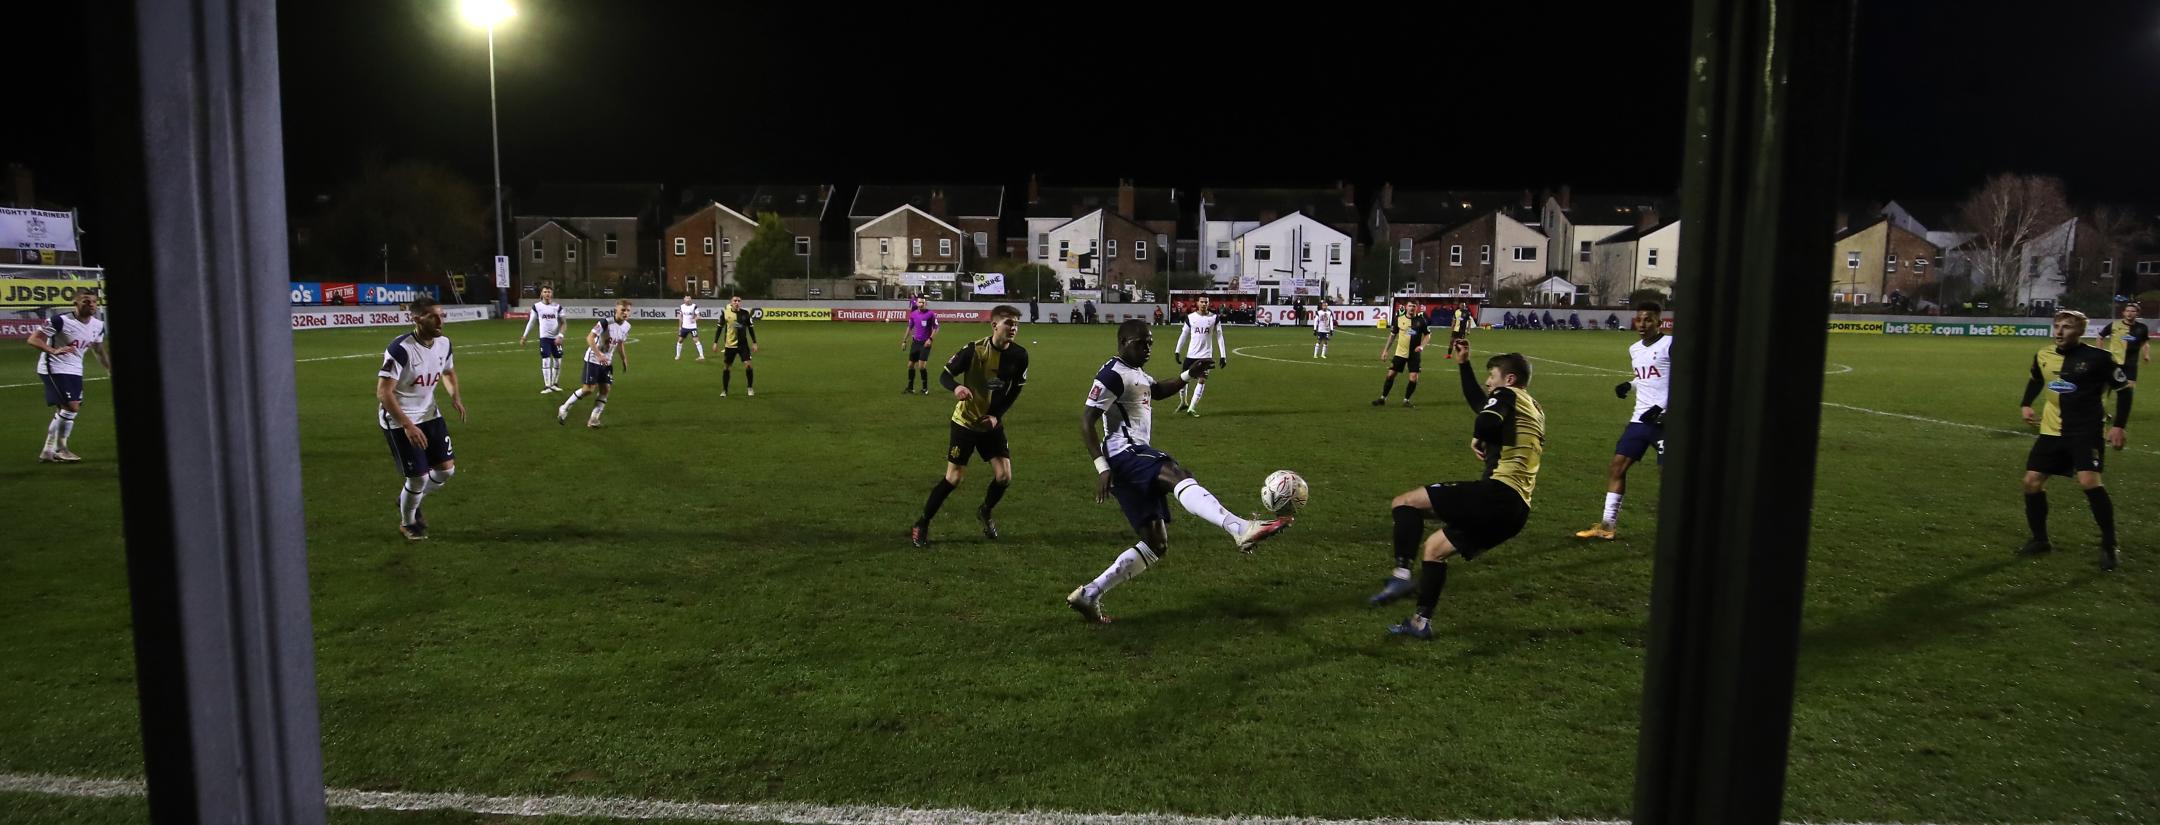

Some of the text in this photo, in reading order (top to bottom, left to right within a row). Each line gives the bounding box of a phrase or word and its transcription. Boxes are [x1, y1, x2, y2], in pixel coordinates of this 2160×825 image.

[31, 210, 70, 219] MARINERS
[977, 275, 1002, 291] MARINE
[344, 287, 355, 296] THIS
[376, 286, 433, 303] Domino's
[332, 313, 364, 325] 32Red
[369, 312, 400, 324] 32Red
[640, 309, 666, 318] Index
[753, 310, 763, 319] JD
[837, 311, 907, 320] Emirates FLY BETTER
[1257, 307, 1273, 323] 23
[292, 315, 327, 327] 32Red
[3, 325, 18, 334] FA
[1194, 326, 1210, 335] AIA
[1886, 323, 1964, 336] bet365.com
[1969, 324, 2048, 336] bet365.com
[410, 372, 441, 387] AIA
[445, 435, 453, 456] 2
